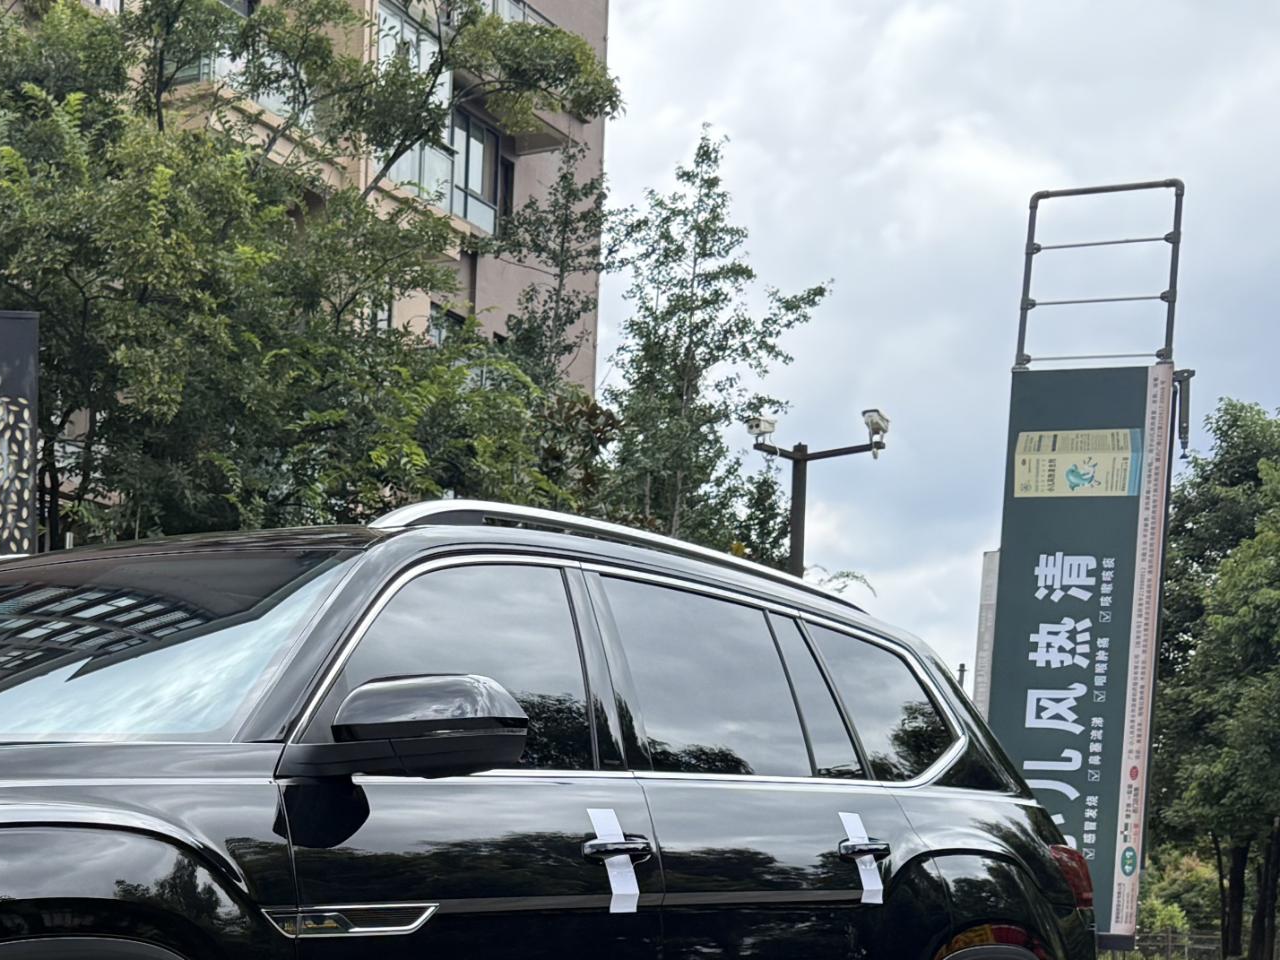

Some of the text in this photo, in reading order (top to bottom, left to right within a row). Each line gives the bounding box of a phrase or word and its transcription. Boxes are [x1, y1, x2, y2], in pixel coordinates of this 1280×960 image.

[1094, 637, 1110, 687] 咽喉肿痛
[1088, 716, 1105, 765] 鼻塞流涕
[1083, 795, 1100, 844] 感冒发烧
